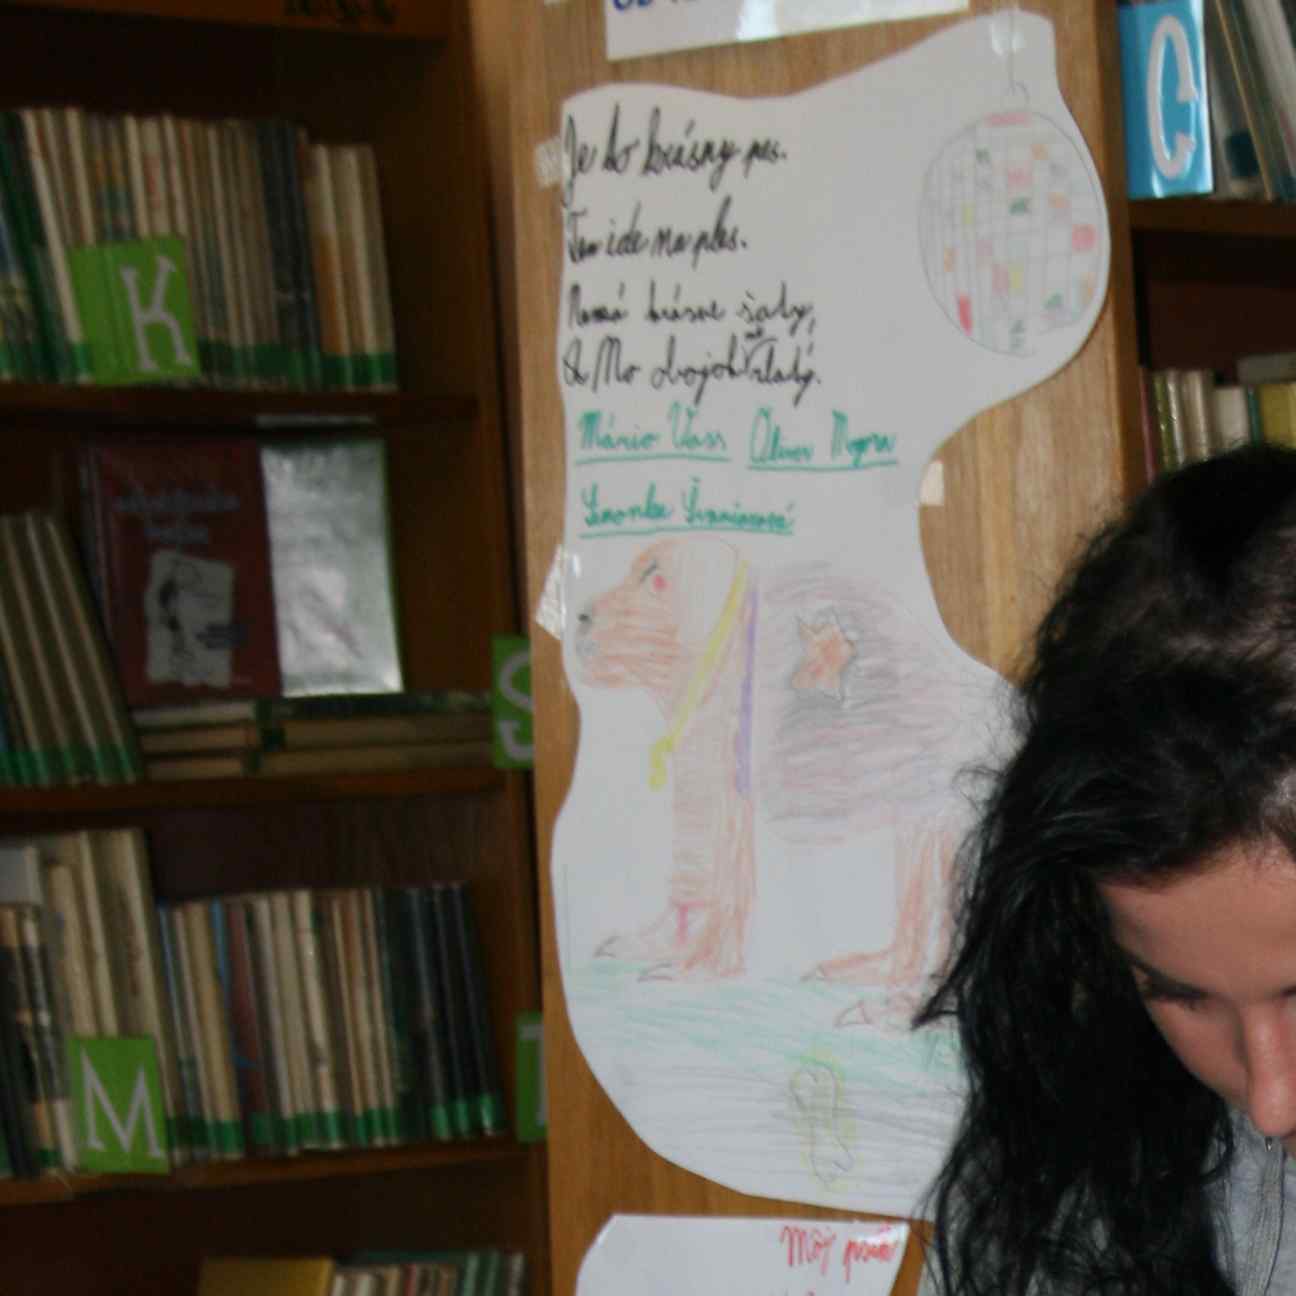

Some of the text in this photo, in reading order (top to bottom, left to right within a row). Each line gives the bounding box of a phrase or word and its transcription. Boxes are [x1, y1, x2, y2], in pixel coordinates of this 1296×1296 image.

[1147, 14, 1199, 180] C
[120, 255, 193, 373] K
[79, 1047, 167, 1161] M
